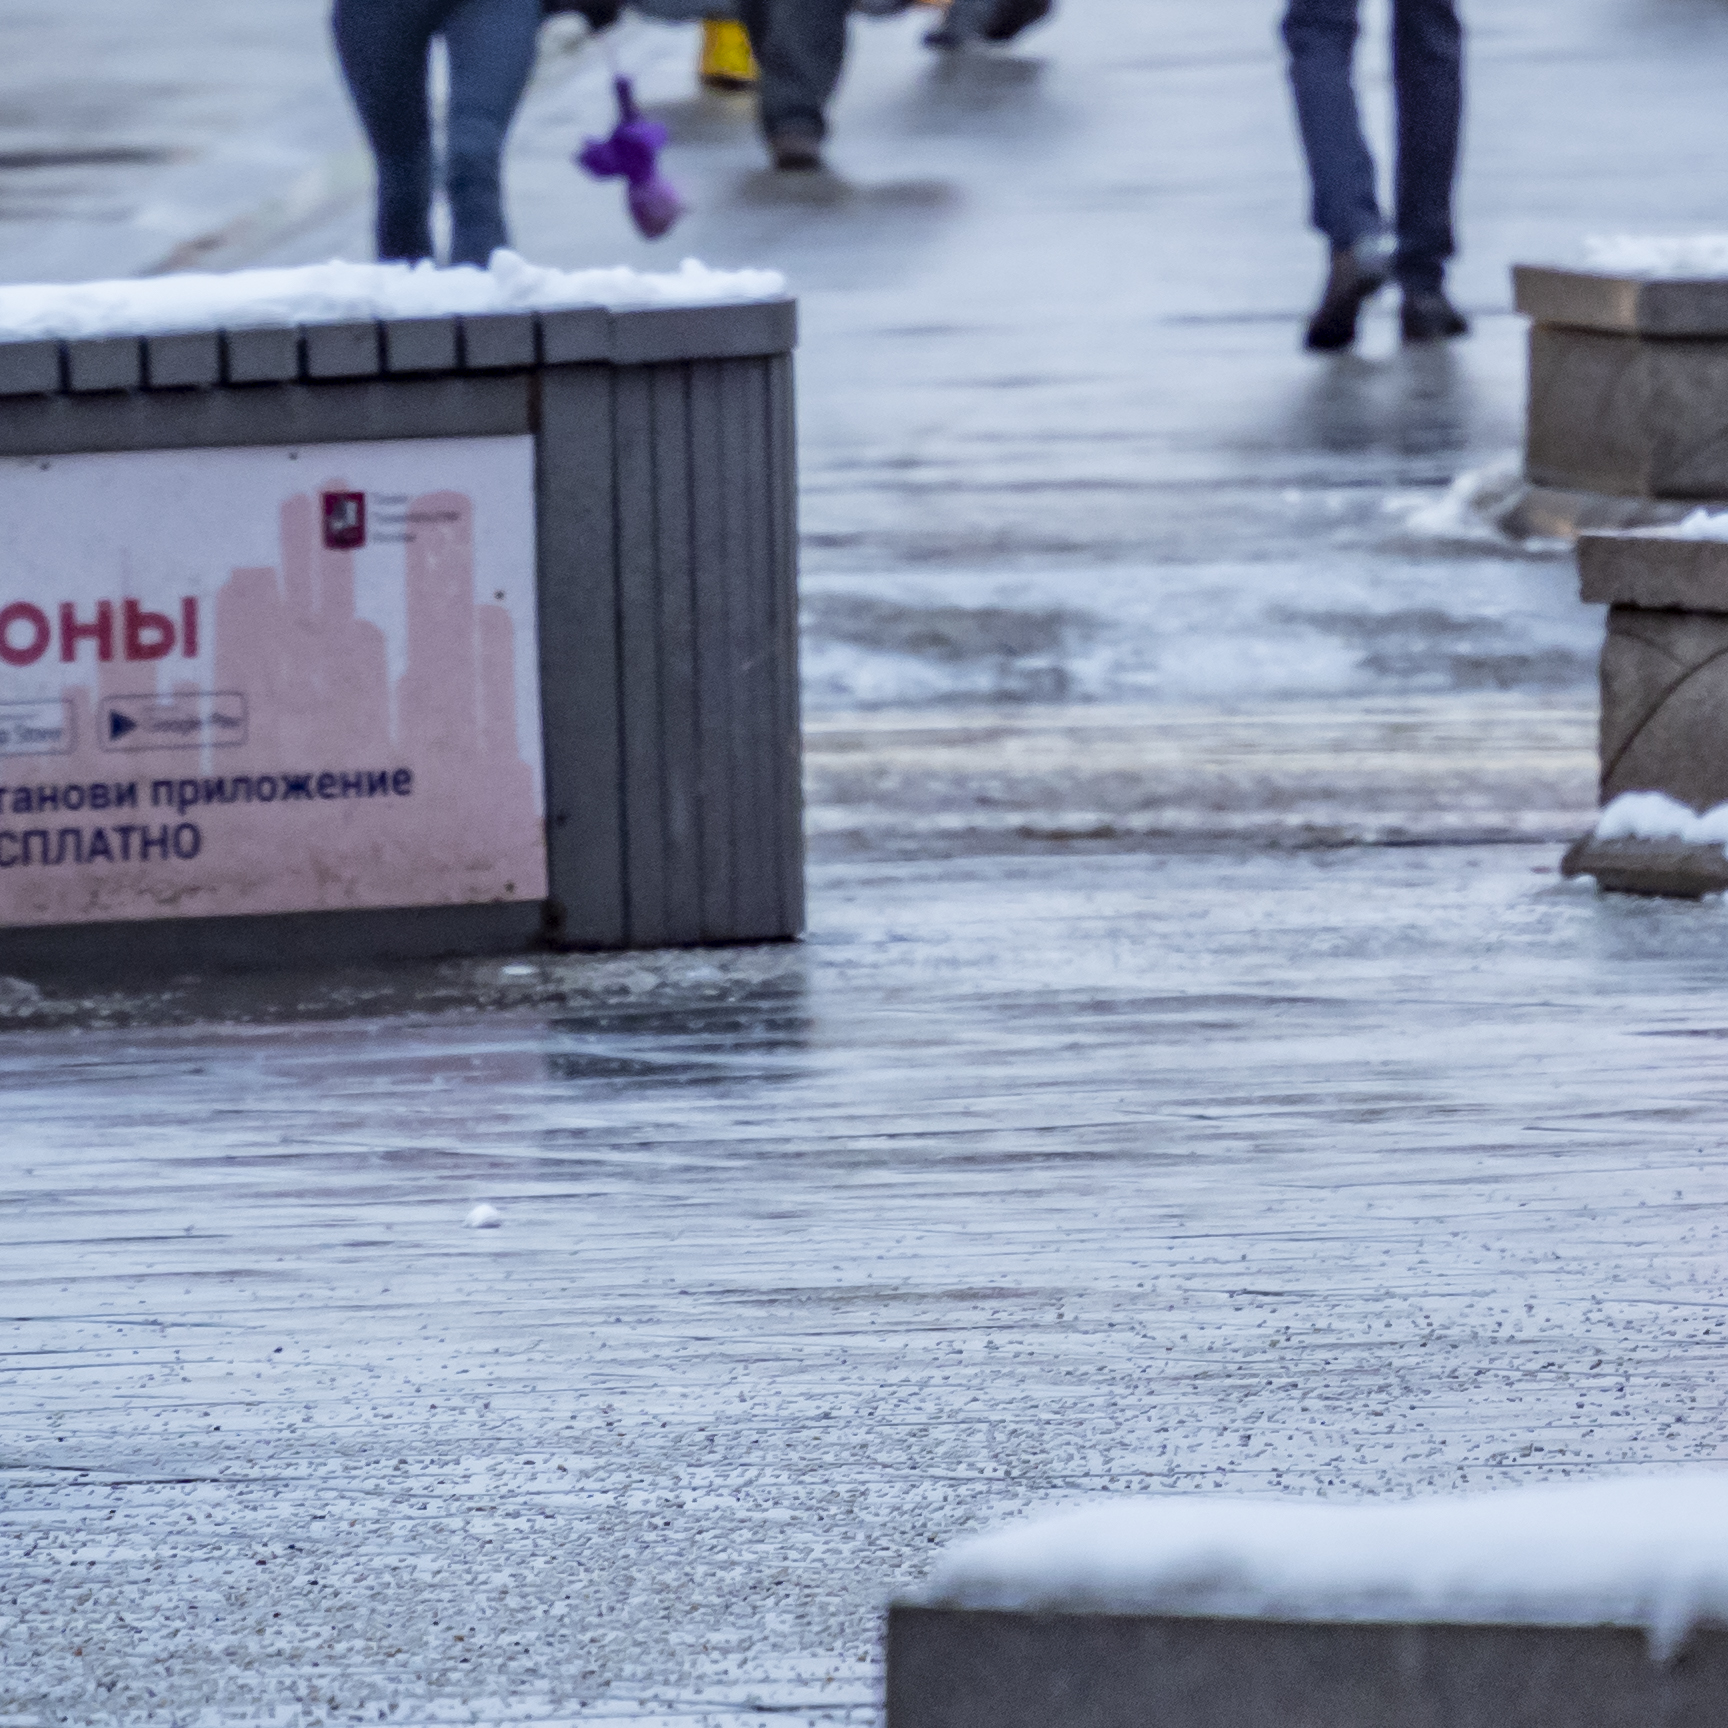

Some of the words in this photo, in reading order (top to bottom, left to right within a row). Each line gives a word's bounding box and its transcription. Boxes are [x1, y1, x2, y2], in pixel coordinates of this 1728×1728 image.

[0, 595, 198, 667] ОНЫ
[151, 768, 413, 814] приложение
[0, 821, 202, 869] СПЛАТНО
